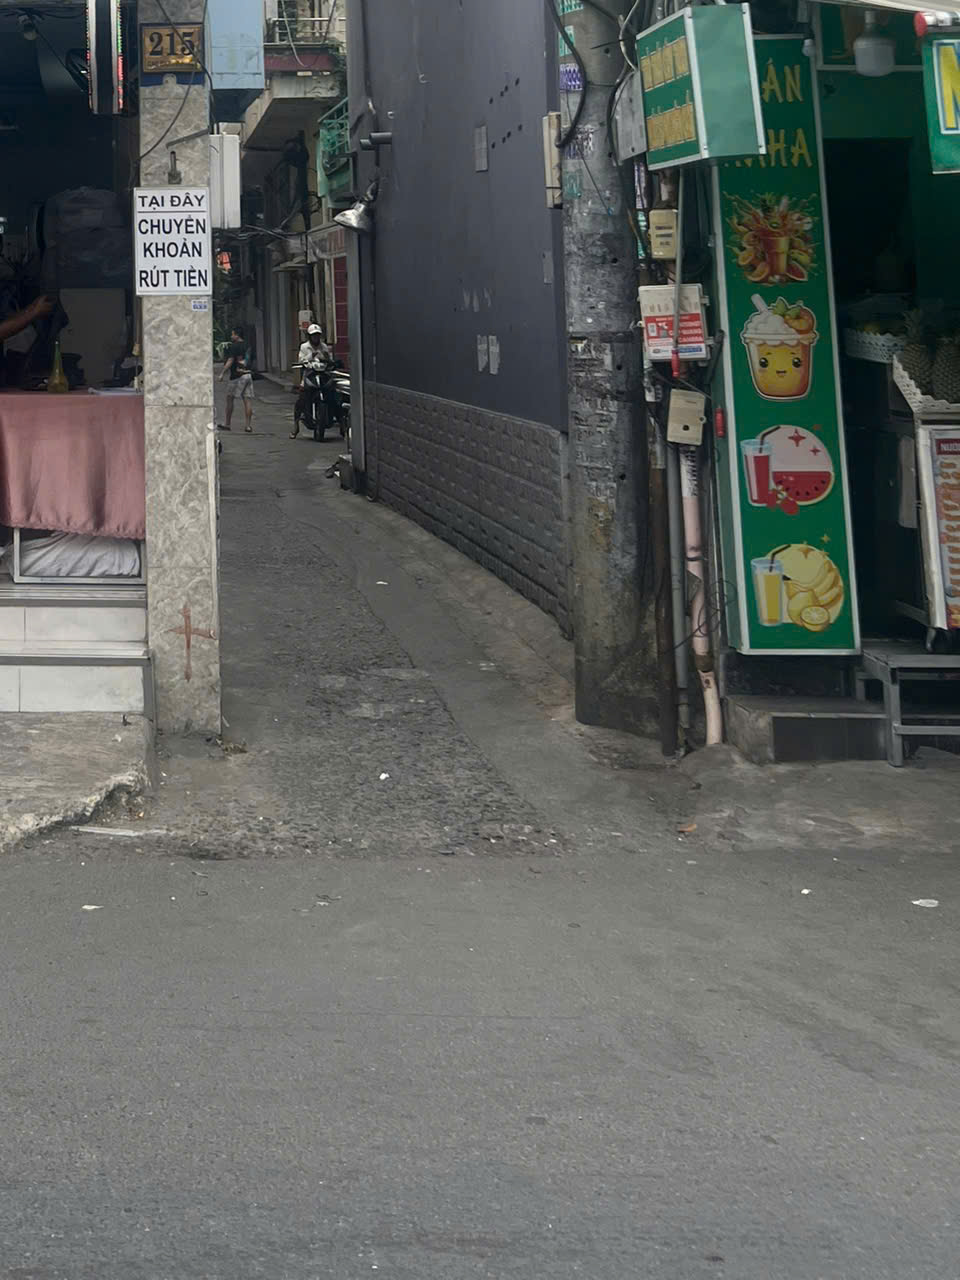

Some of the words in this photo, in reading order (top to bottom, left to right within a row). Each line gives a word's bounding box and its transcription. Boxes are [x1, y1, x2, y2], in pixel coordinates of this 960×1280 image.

[149, 32, 195, 56] 215
[138, 195, 164, 210] TẠI
[170, 192, 204, 207] ĐÂY
[139, 265, 169, 287] RÚT
[174, 265, 208, 287] TIỀN
